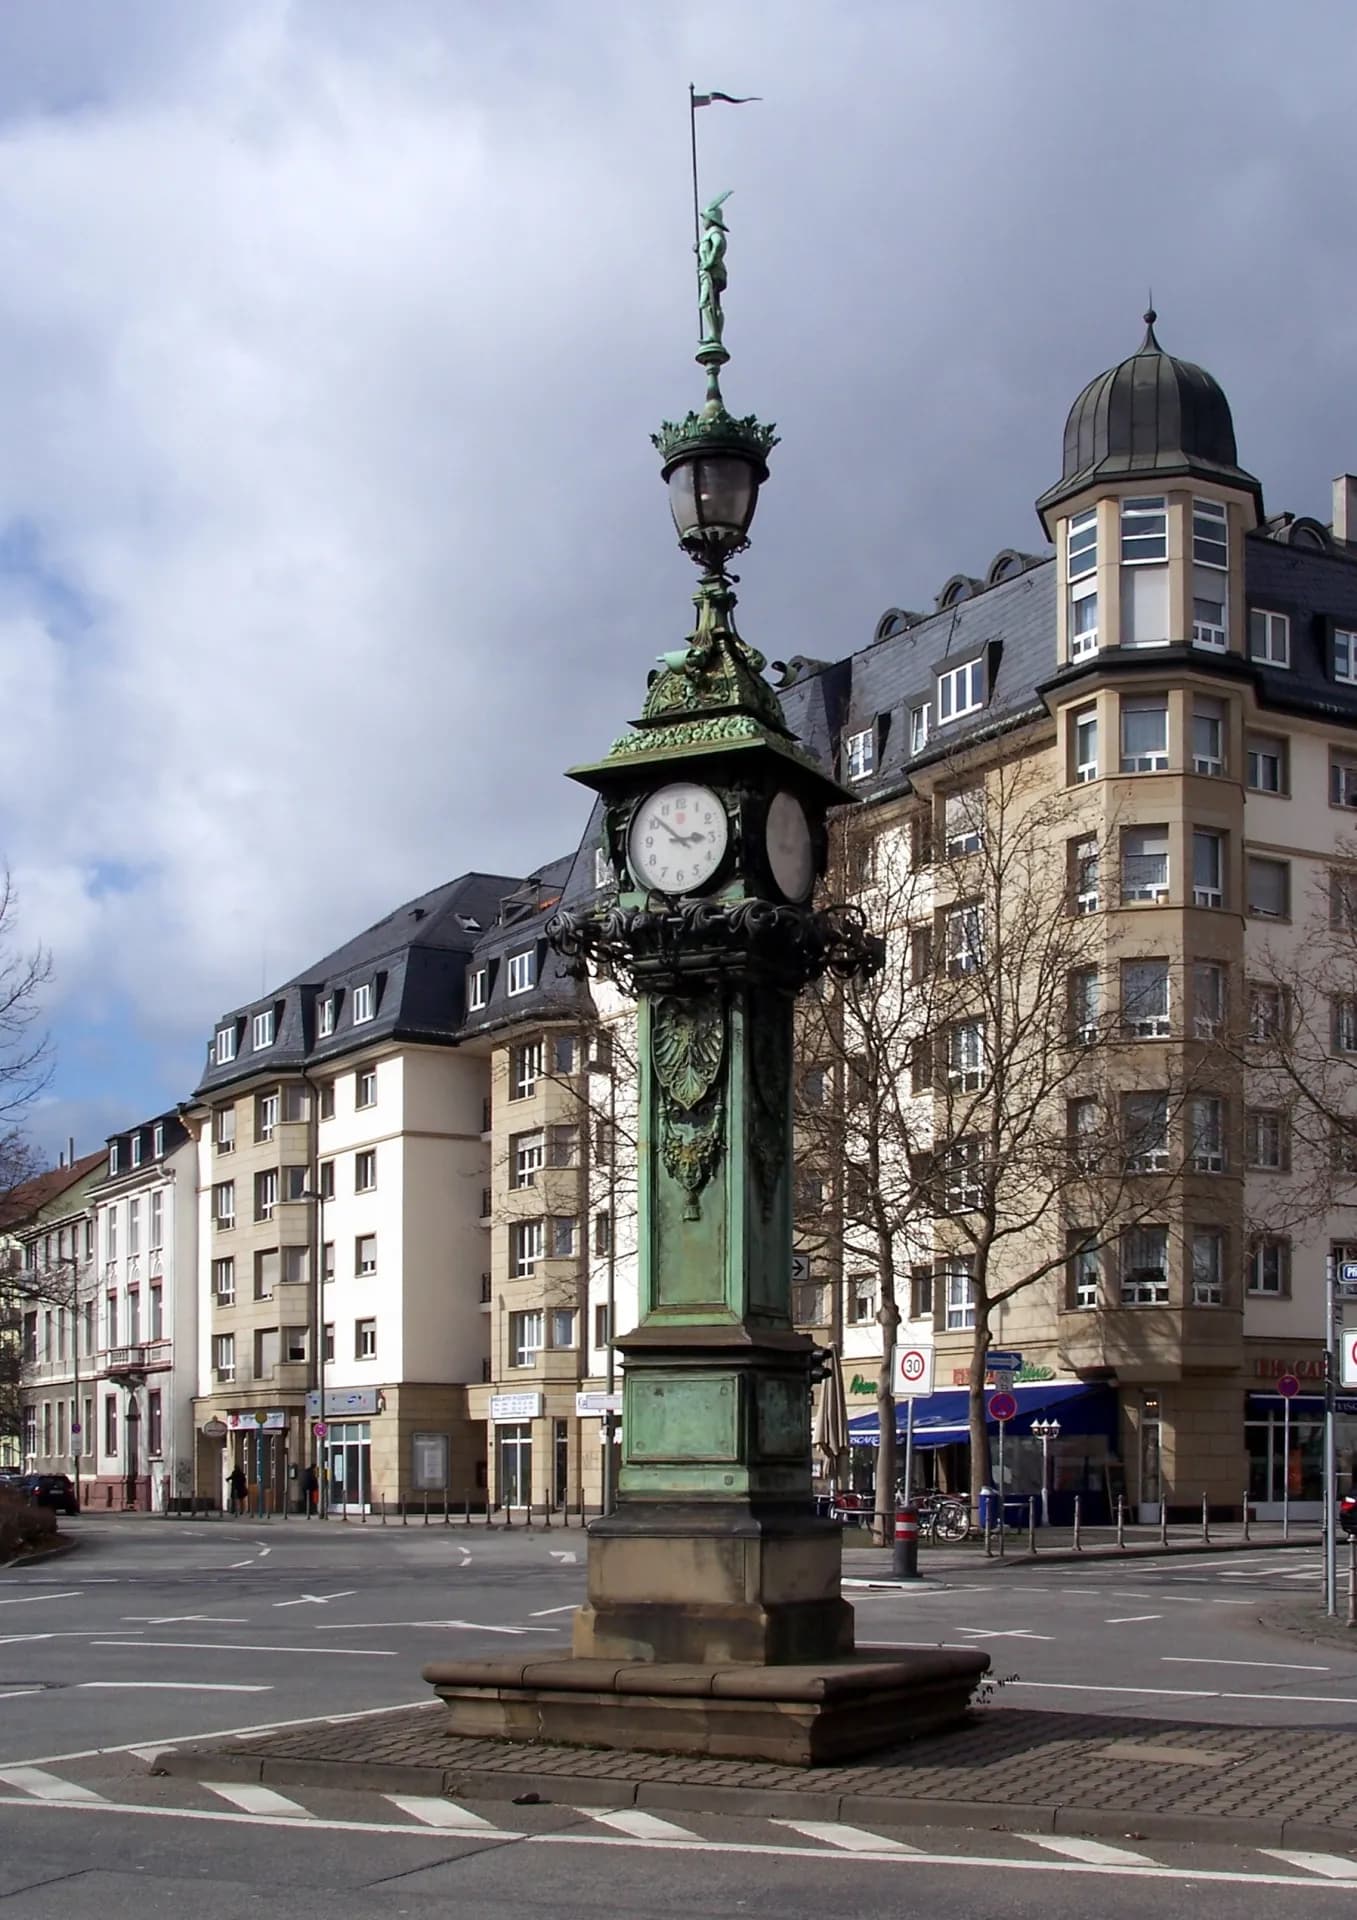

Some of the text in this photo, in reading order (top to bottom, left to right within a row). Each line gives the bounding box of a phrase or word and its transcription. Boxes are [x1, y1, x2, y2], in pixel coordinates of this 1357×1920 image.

[675, 798, 687, 809] 12
[703, 812, 713, 825] 2
[645, 836, 654, 848] 9
[649, 855, 656, 866] 8
[677, 869, 685, 881] 6
[906, 1359, 920, 1373] 30
